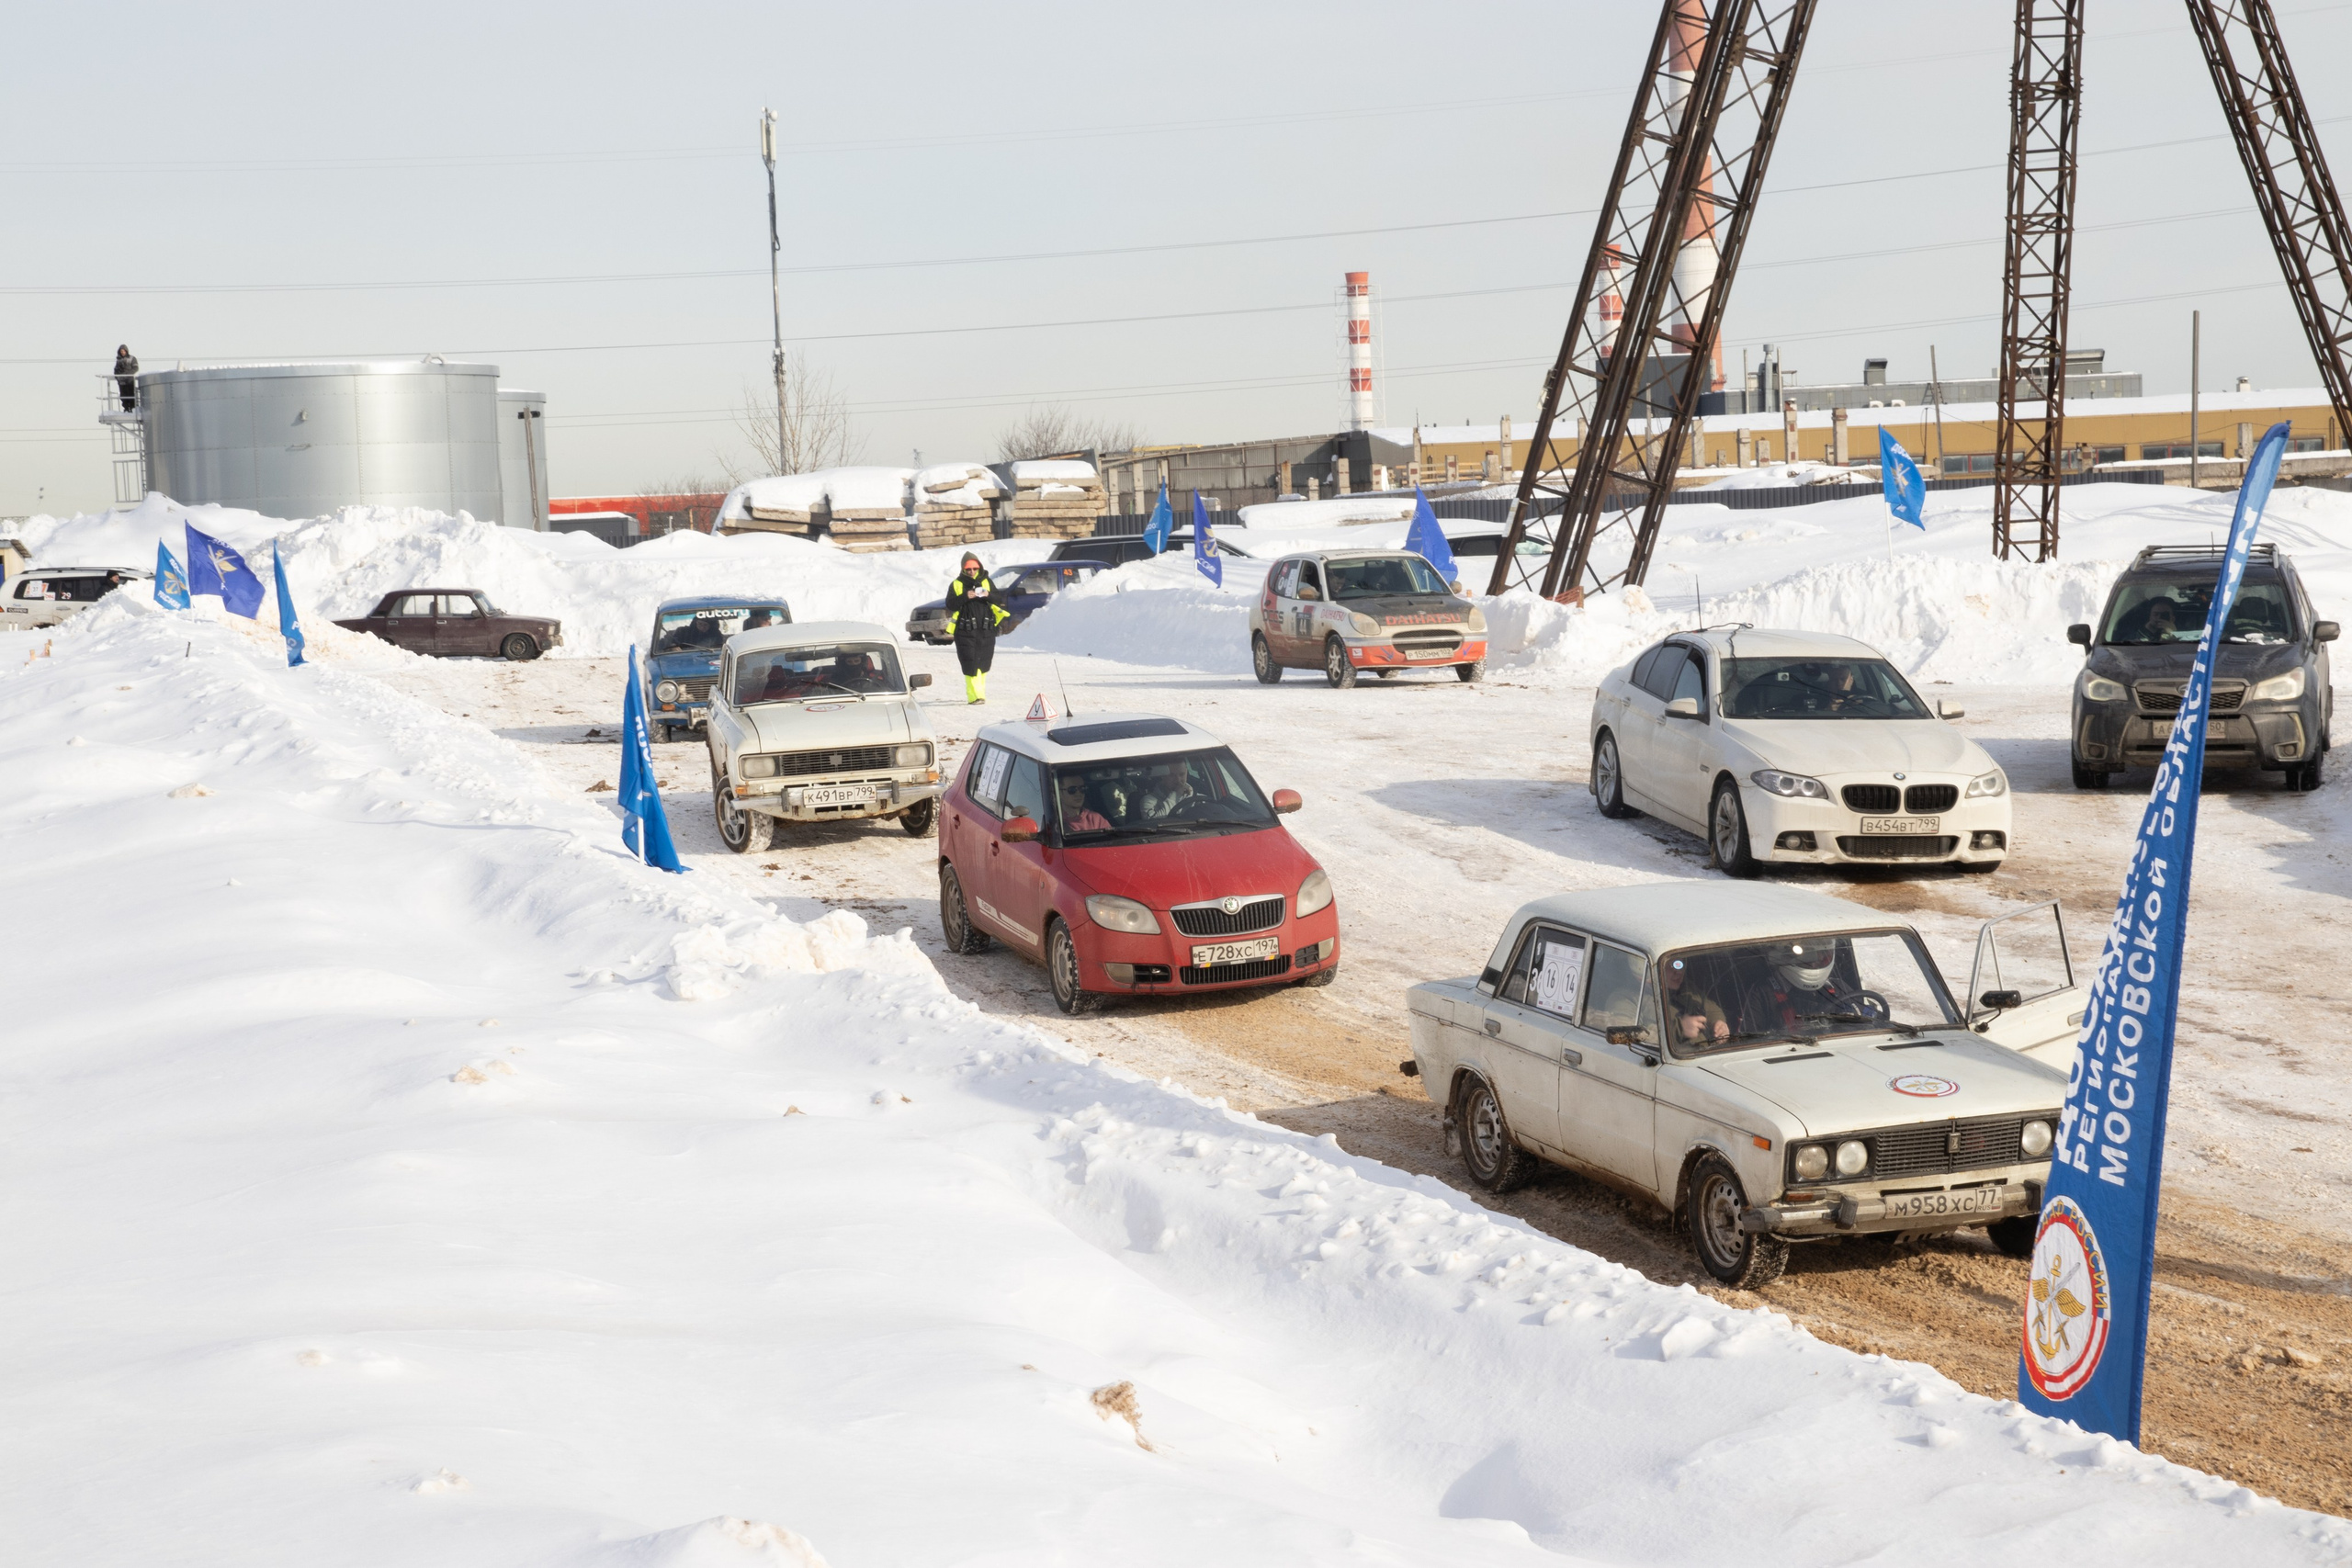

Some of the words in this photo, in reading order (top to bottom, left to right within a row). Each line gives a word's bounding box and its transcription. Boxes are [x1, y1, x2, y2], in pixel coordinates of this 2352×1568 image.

[61, 592, 72, 600] 29
[695, 608, 751, 619] auto.ru
[1385, 613, 1462, 626] DAIHATSU
[808, 789, 854, 803] К491ВР
[855, 786, 873, 796] 799
[1866, 819, 1916, 832] В454ВТ
[1918, 818, 1936, 828] 799
[1198, 945, 1252, 963] Е728ХС
[1255, 939, 1275, 952] 197
[1546, 968, 1556, 989] 16
[1566, 973, 1576, 994] 14
[2099, 857, 2167, 1187] МОСКОВСКОЙ
[1894, 1195, 1974, 1216] М958ХС
[1978, 1189, 1996, 1205] 77
[2069, 1204, 2109, 1310] РОССИИ
